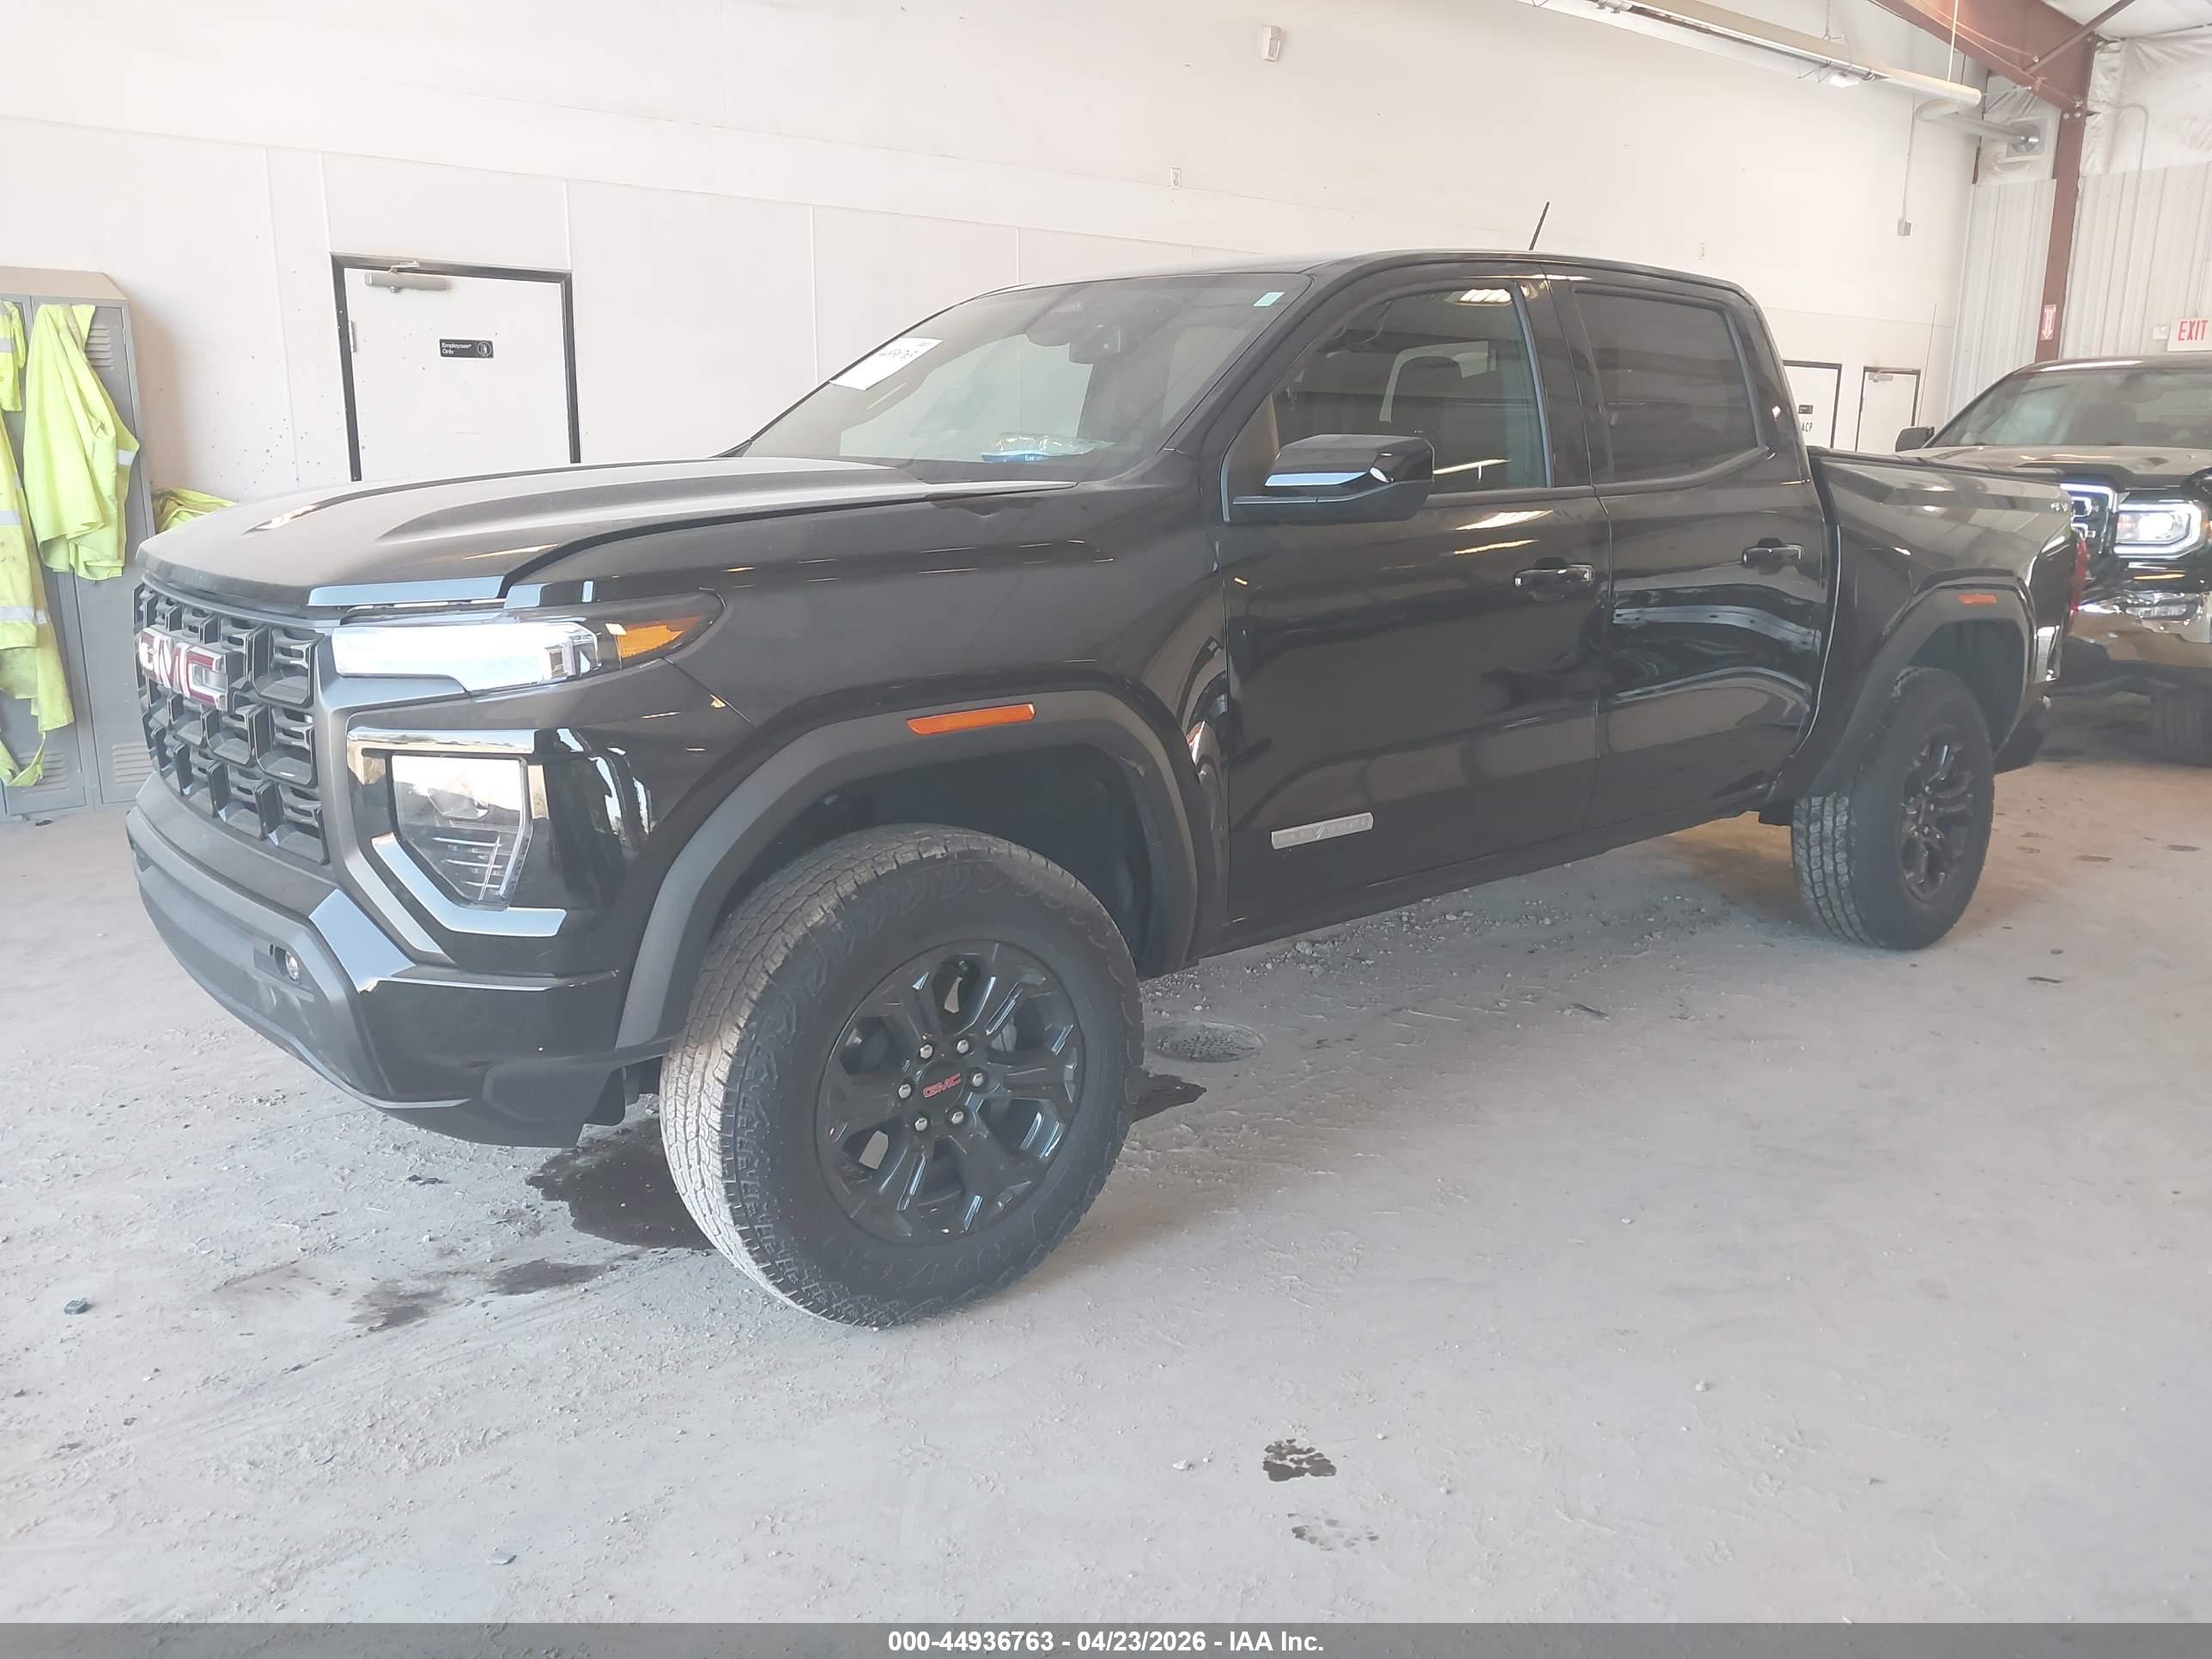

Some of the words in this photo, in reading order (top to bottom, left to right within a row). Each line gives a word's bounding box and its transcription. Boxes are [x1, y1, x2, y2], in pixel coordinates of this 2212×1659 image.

[2178, 319, 2209, 341] EXIT
[138, 625, 228, 711] GMC
[923, 1073, 962, 1098] GMC
